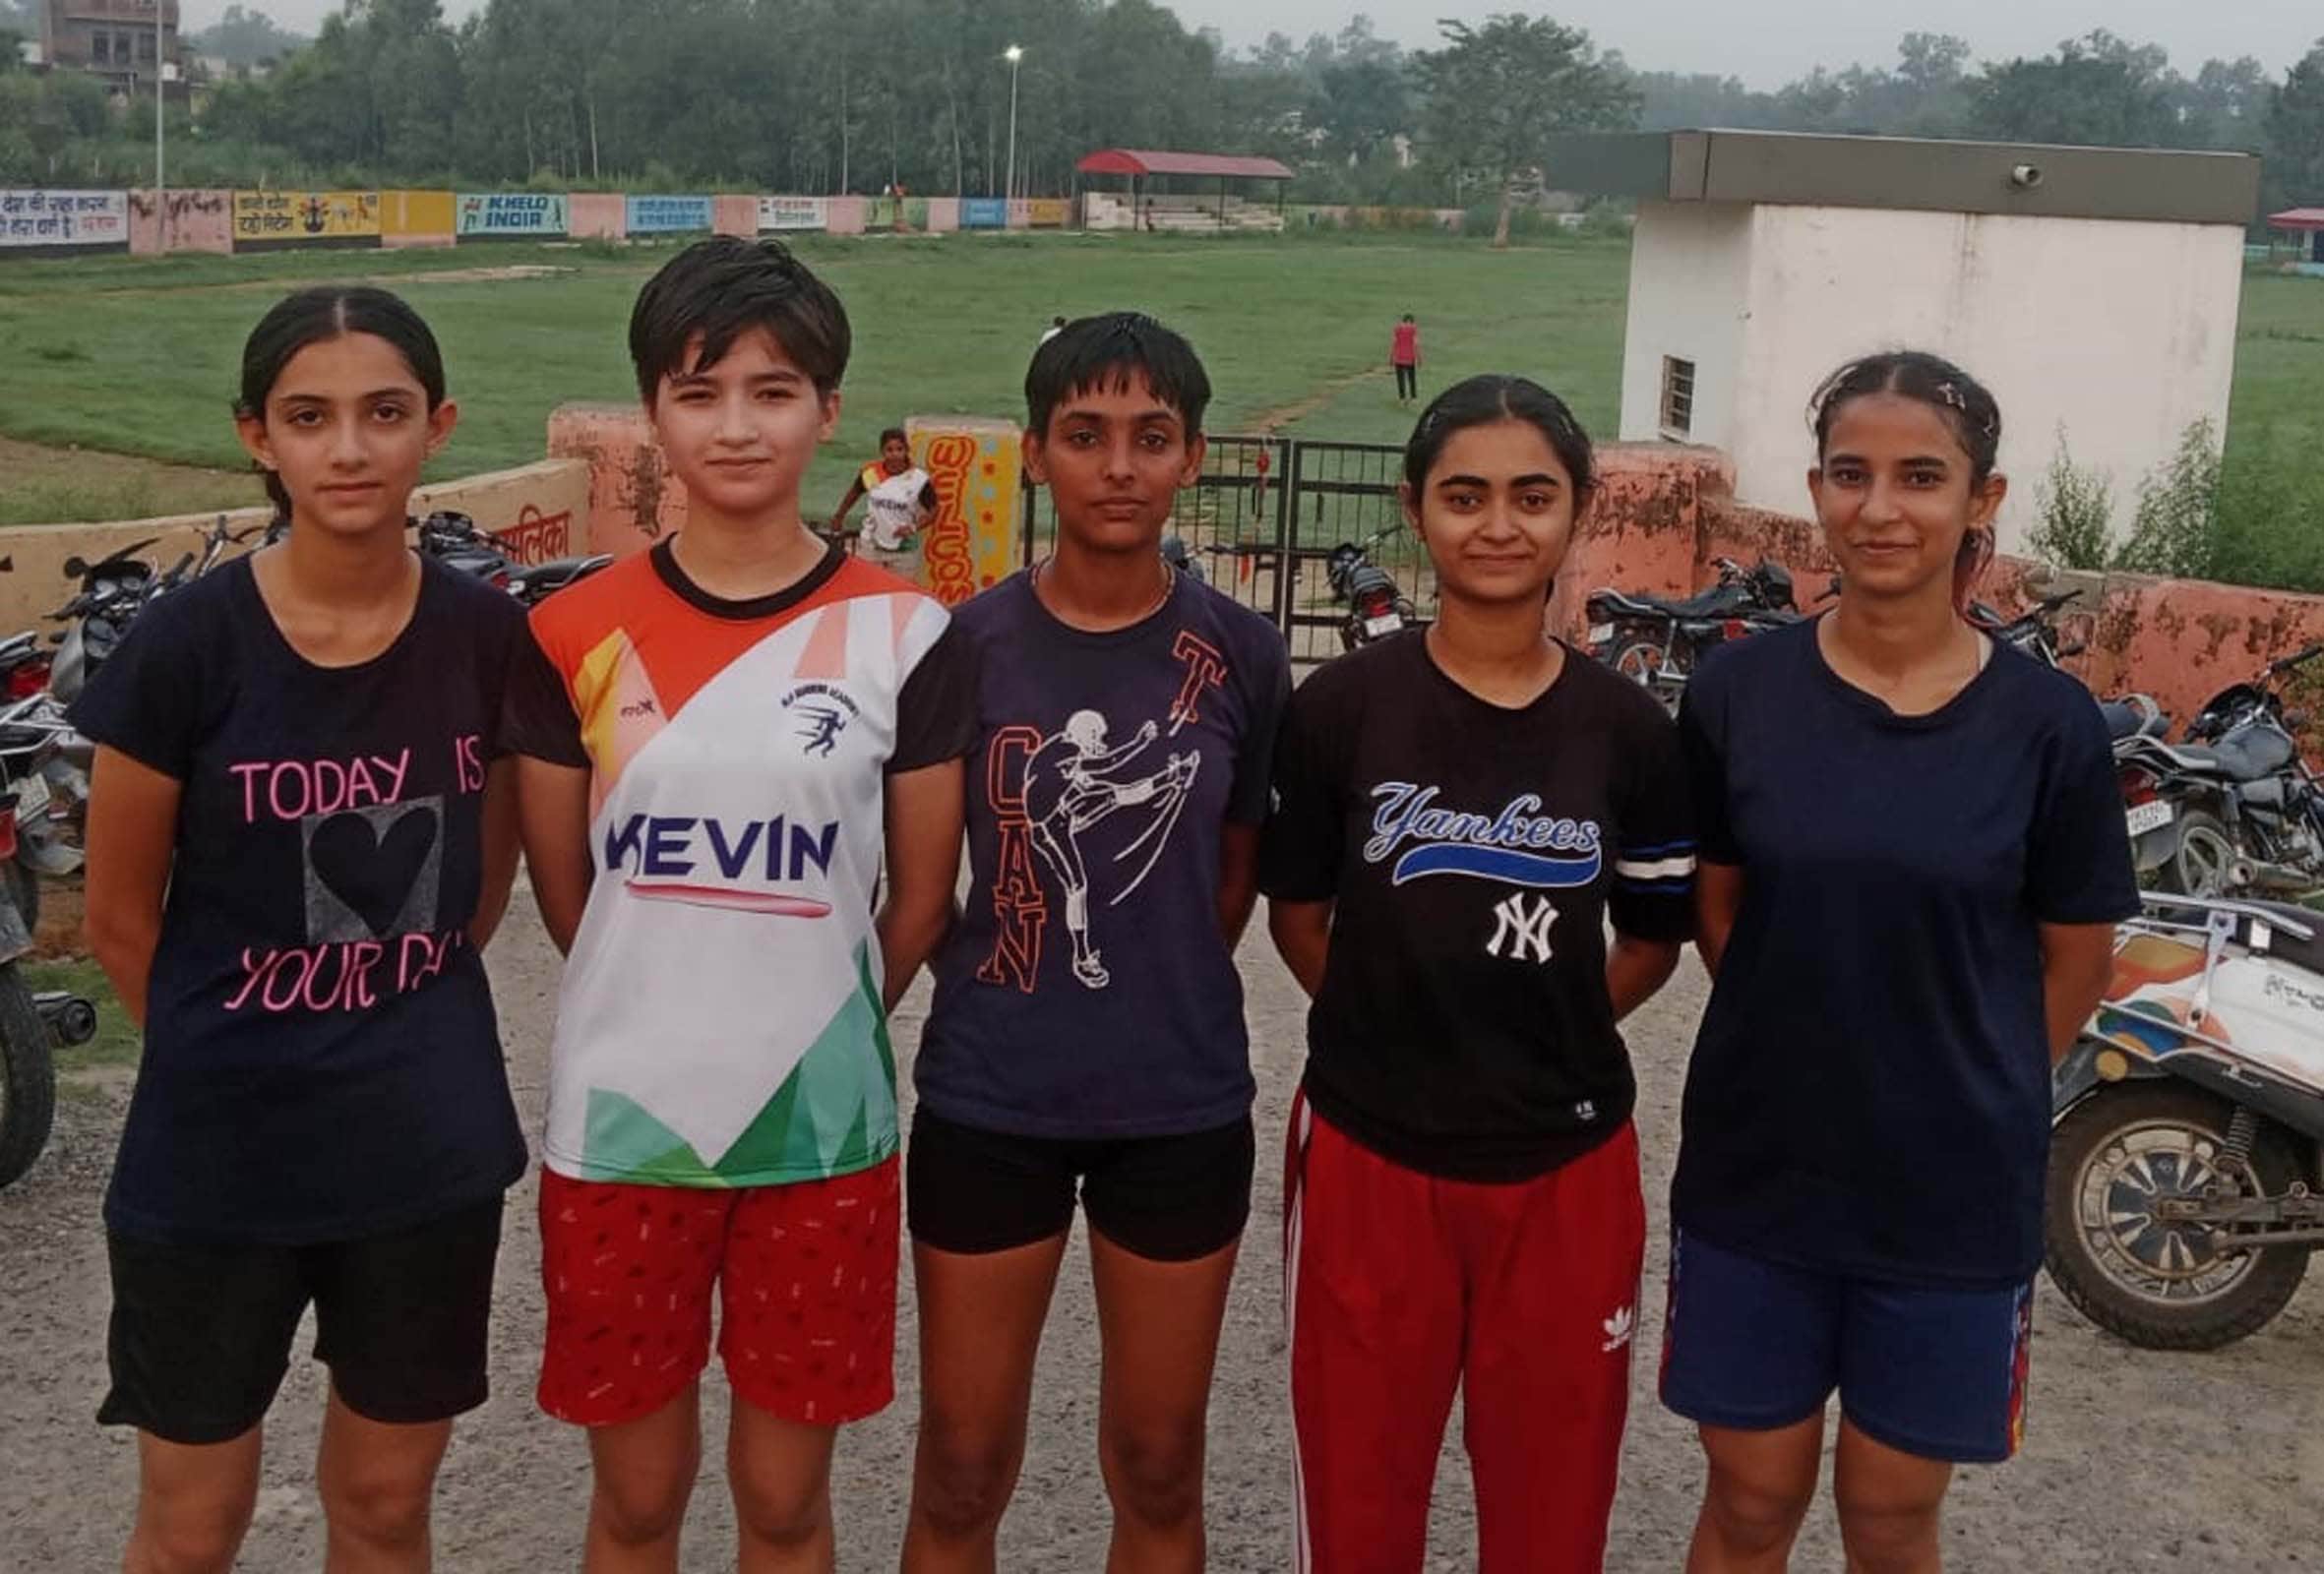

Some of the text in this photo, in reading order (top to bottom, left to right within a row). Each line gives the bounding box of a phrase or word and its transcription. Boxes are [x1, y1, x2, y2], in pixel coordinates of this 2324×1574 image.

[485, 212, 542, 227] INDIA
[488, 196, 548, 211] KHELO
[229, 735, 486, 823] TODAY IS
[604, 813, 840, 881] KEVIN
[1363, 781, 1601, 863] Yankees
[976, 726, 1047, 994] CAN
[1486, 891, 1560, 965] NY
[223, 941, 383, 1012] YOUR
